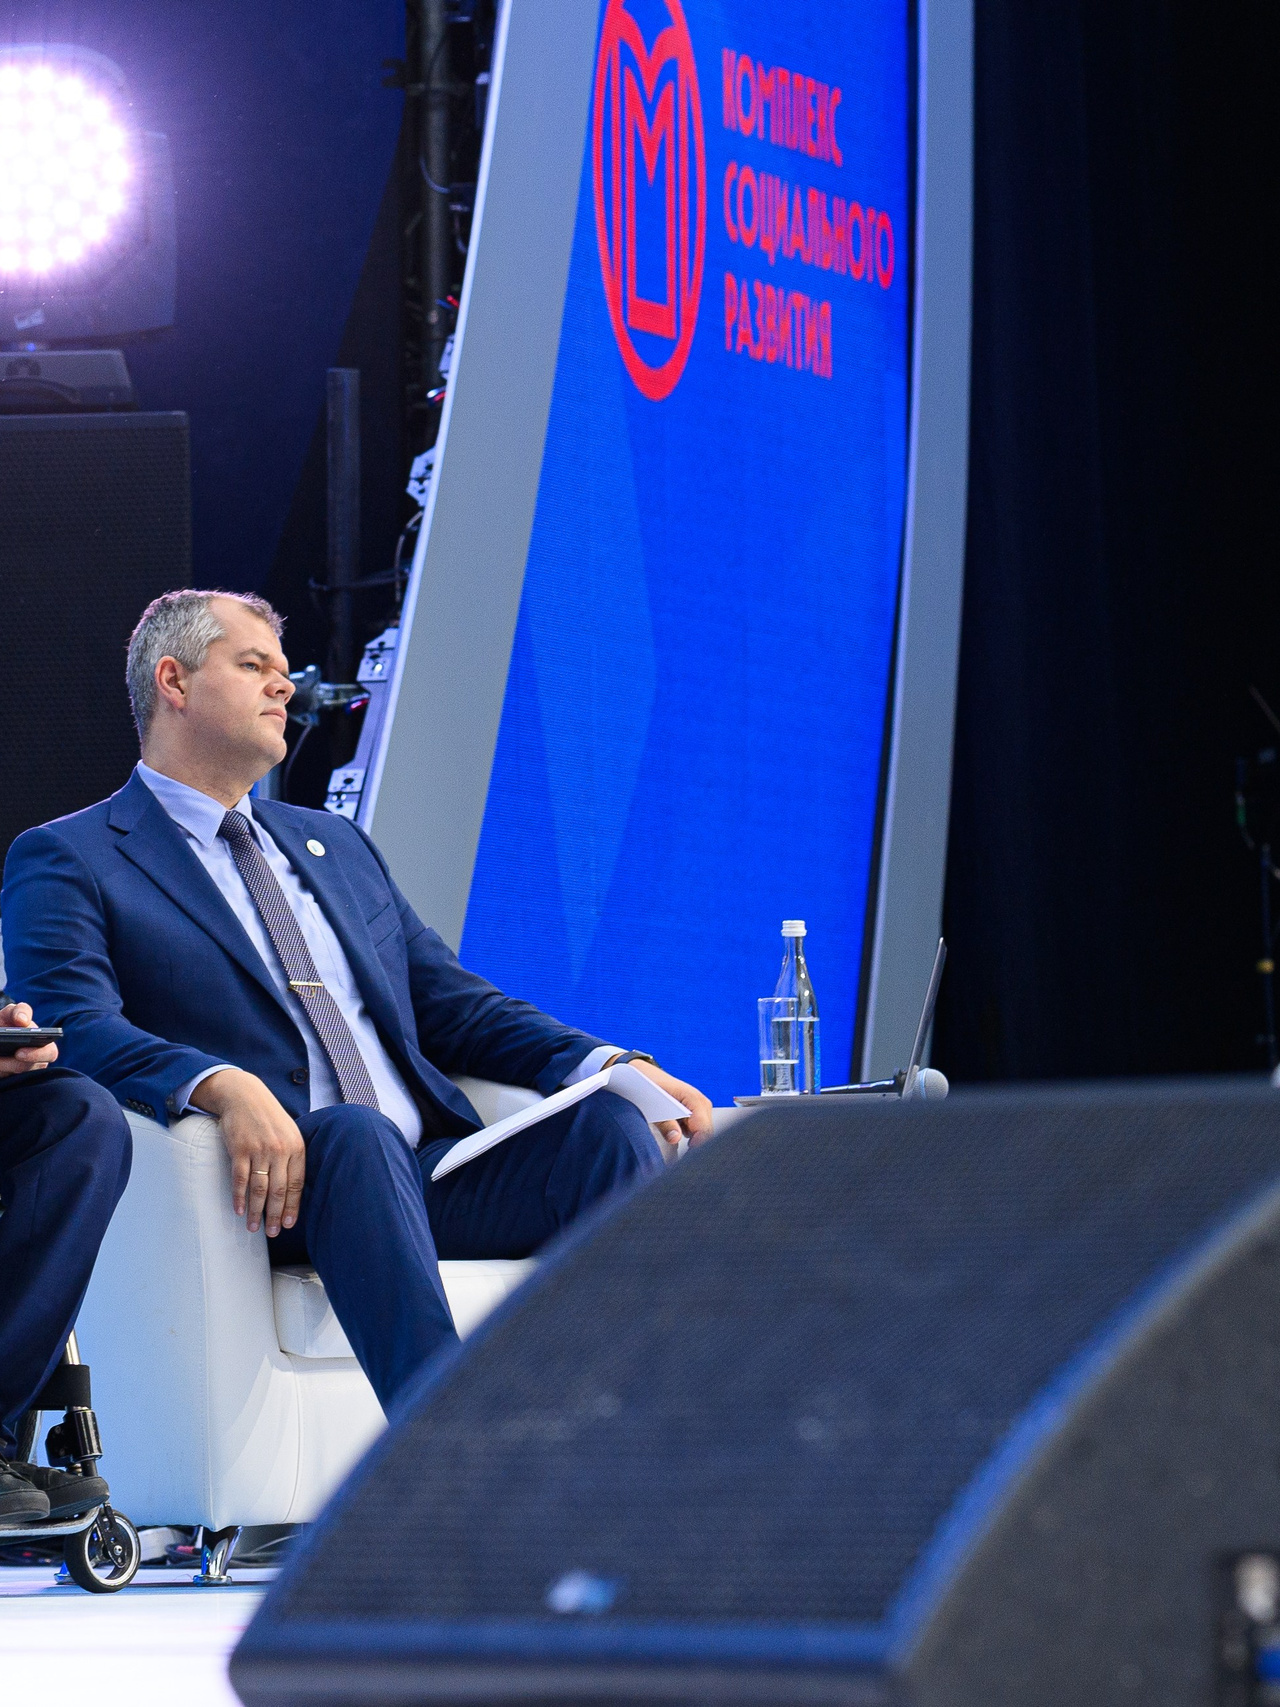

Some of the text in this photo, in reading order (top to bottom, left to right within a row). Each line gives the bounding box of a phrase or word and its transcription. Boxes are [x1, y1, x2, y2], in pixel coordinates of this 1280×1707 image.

[722, 48, 843, 168] КОМПЛЕКС
[724, 161, 895, 290] СОЦИАЛЬНОГО
[724, 271, 832, 380] РАЗВИТИЯ
